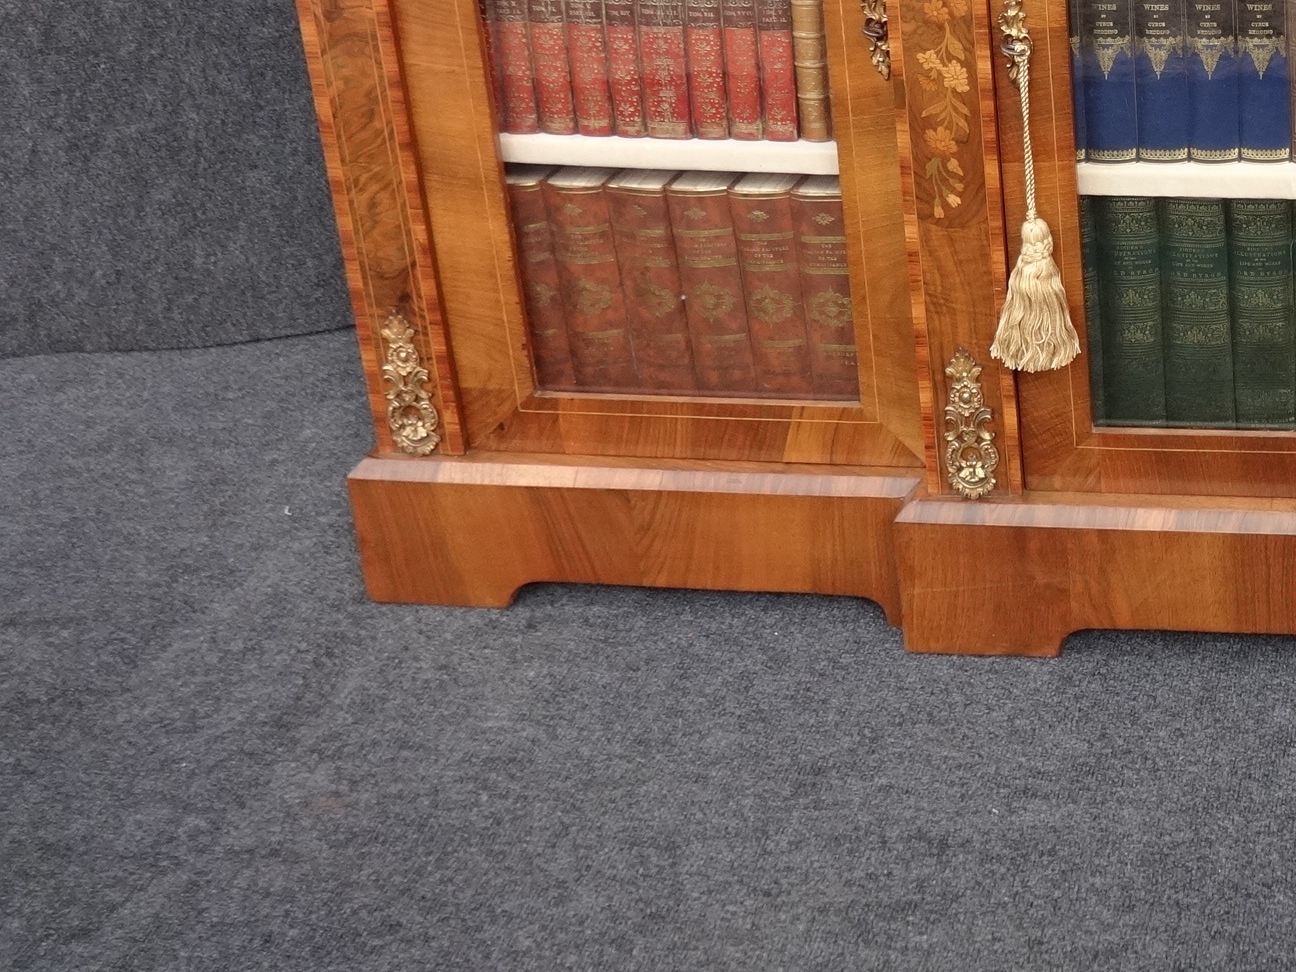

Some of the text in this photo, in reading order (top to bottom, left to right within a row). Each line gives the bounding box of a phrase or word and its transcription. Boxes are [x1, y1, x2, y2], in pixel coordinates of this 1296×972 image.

[1091, 3, 1117, 11] WINES
[1142, 3, 1169, 11] WINES
[1195, 3, 1221, 11] WINES
[1246, 3, 1273, 11] WINES
